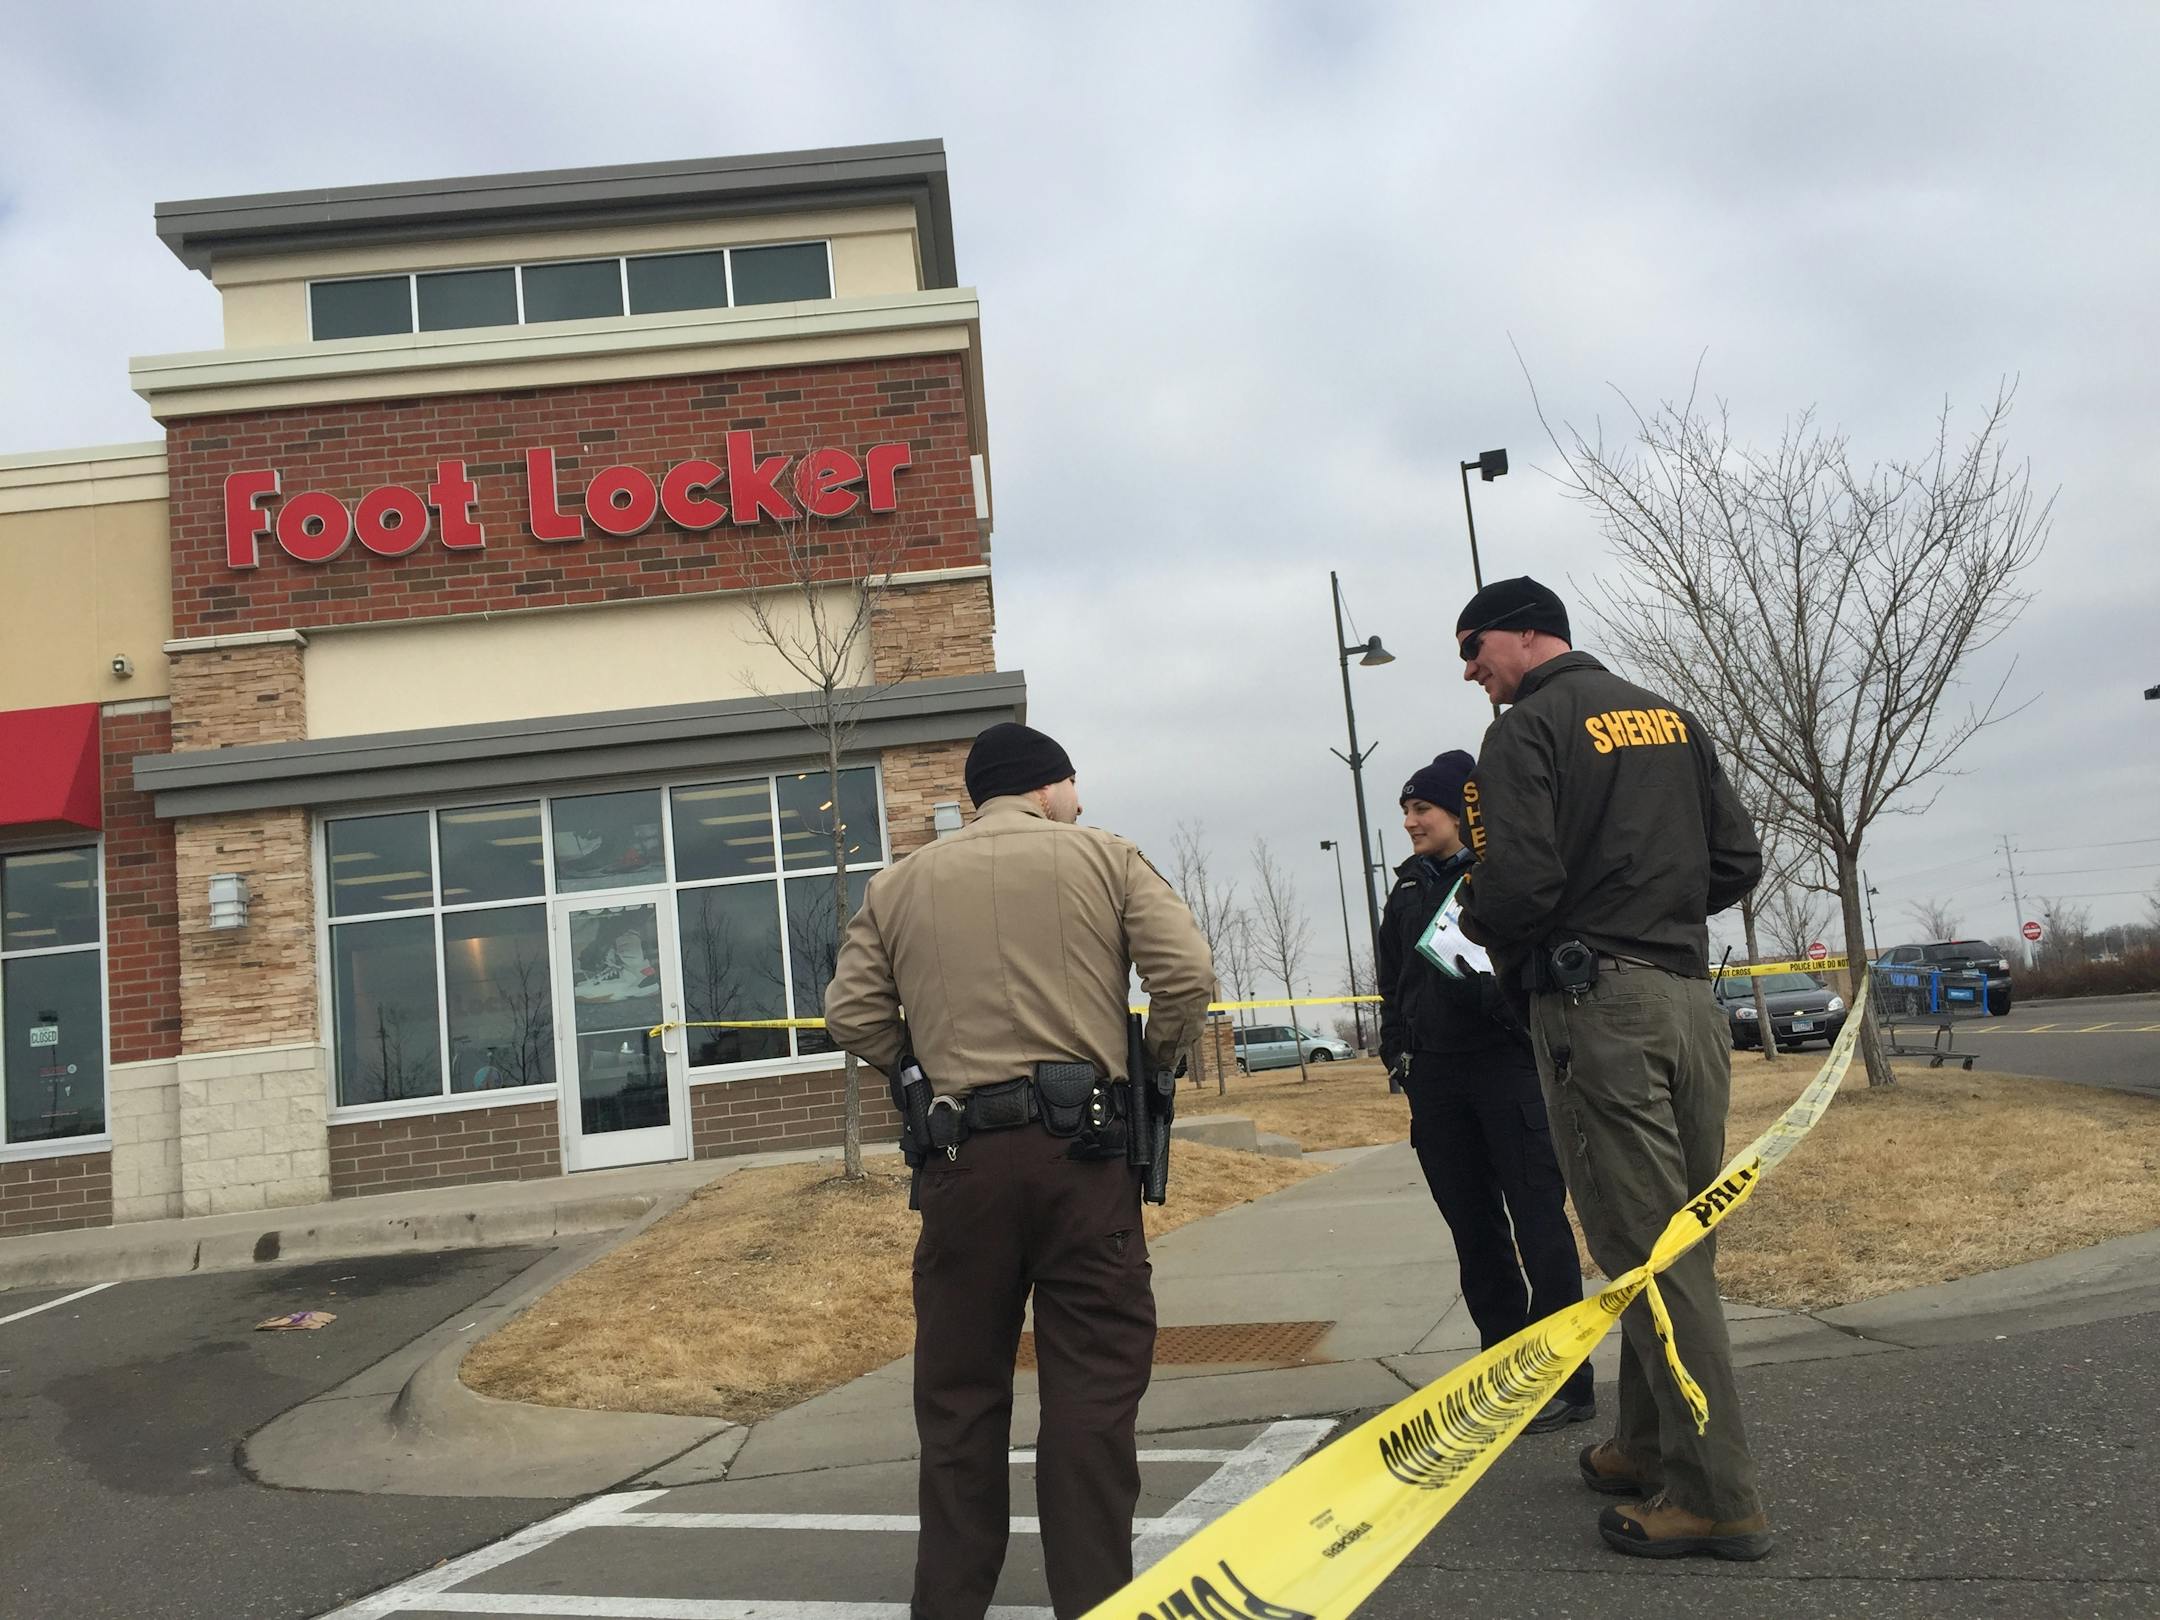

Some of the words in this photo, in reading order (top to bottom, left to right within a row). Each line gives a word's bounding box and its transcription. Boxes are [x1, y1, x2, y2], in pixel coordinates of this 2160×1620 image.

[224, 459, 486, 569] Foot
[526, 431, 911, 542] Locker
[1585, 708, 1689, 753] SHERIFF
[1790, 961, 1810, 972] POLICE
[1812, 960, 1826, 970] LINE
[1827, 959, 1836, 968] DO
[1731, 968, 1752, 977] CROSS
[31, 1031, 56, 1043] CLOSED
